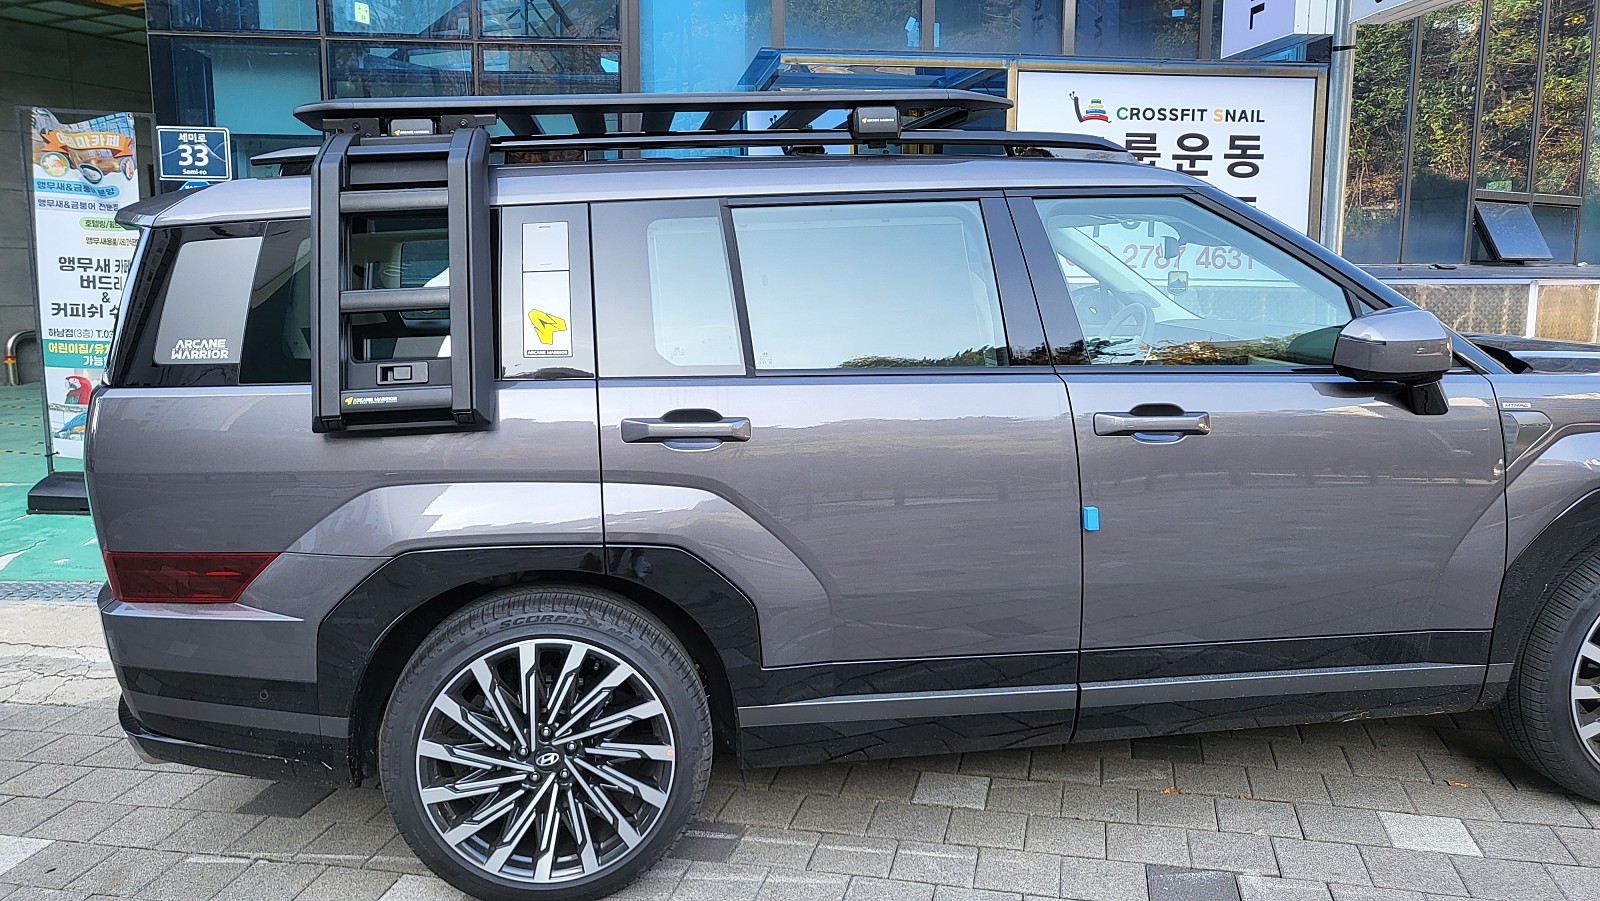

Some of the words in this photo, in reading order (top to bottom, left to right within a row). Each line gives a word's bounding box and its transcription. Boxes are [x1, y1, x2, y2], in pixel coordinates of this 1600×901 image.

[1116, 106, 1208, 122] CROSSFIT
[1213, 108, 1266, 123] SNAIL
[178, 132, 207, 143] 세미로
[178, 144, 209, 166] 33
[58, 256, 111, 273] 앵무새
[102, 291, 111, 303] &
[51, 302, 104, 318] 커피쉬
[175, 338, 227, 349] ARCANE
[171, 349, 229, 360] WARRIOR
